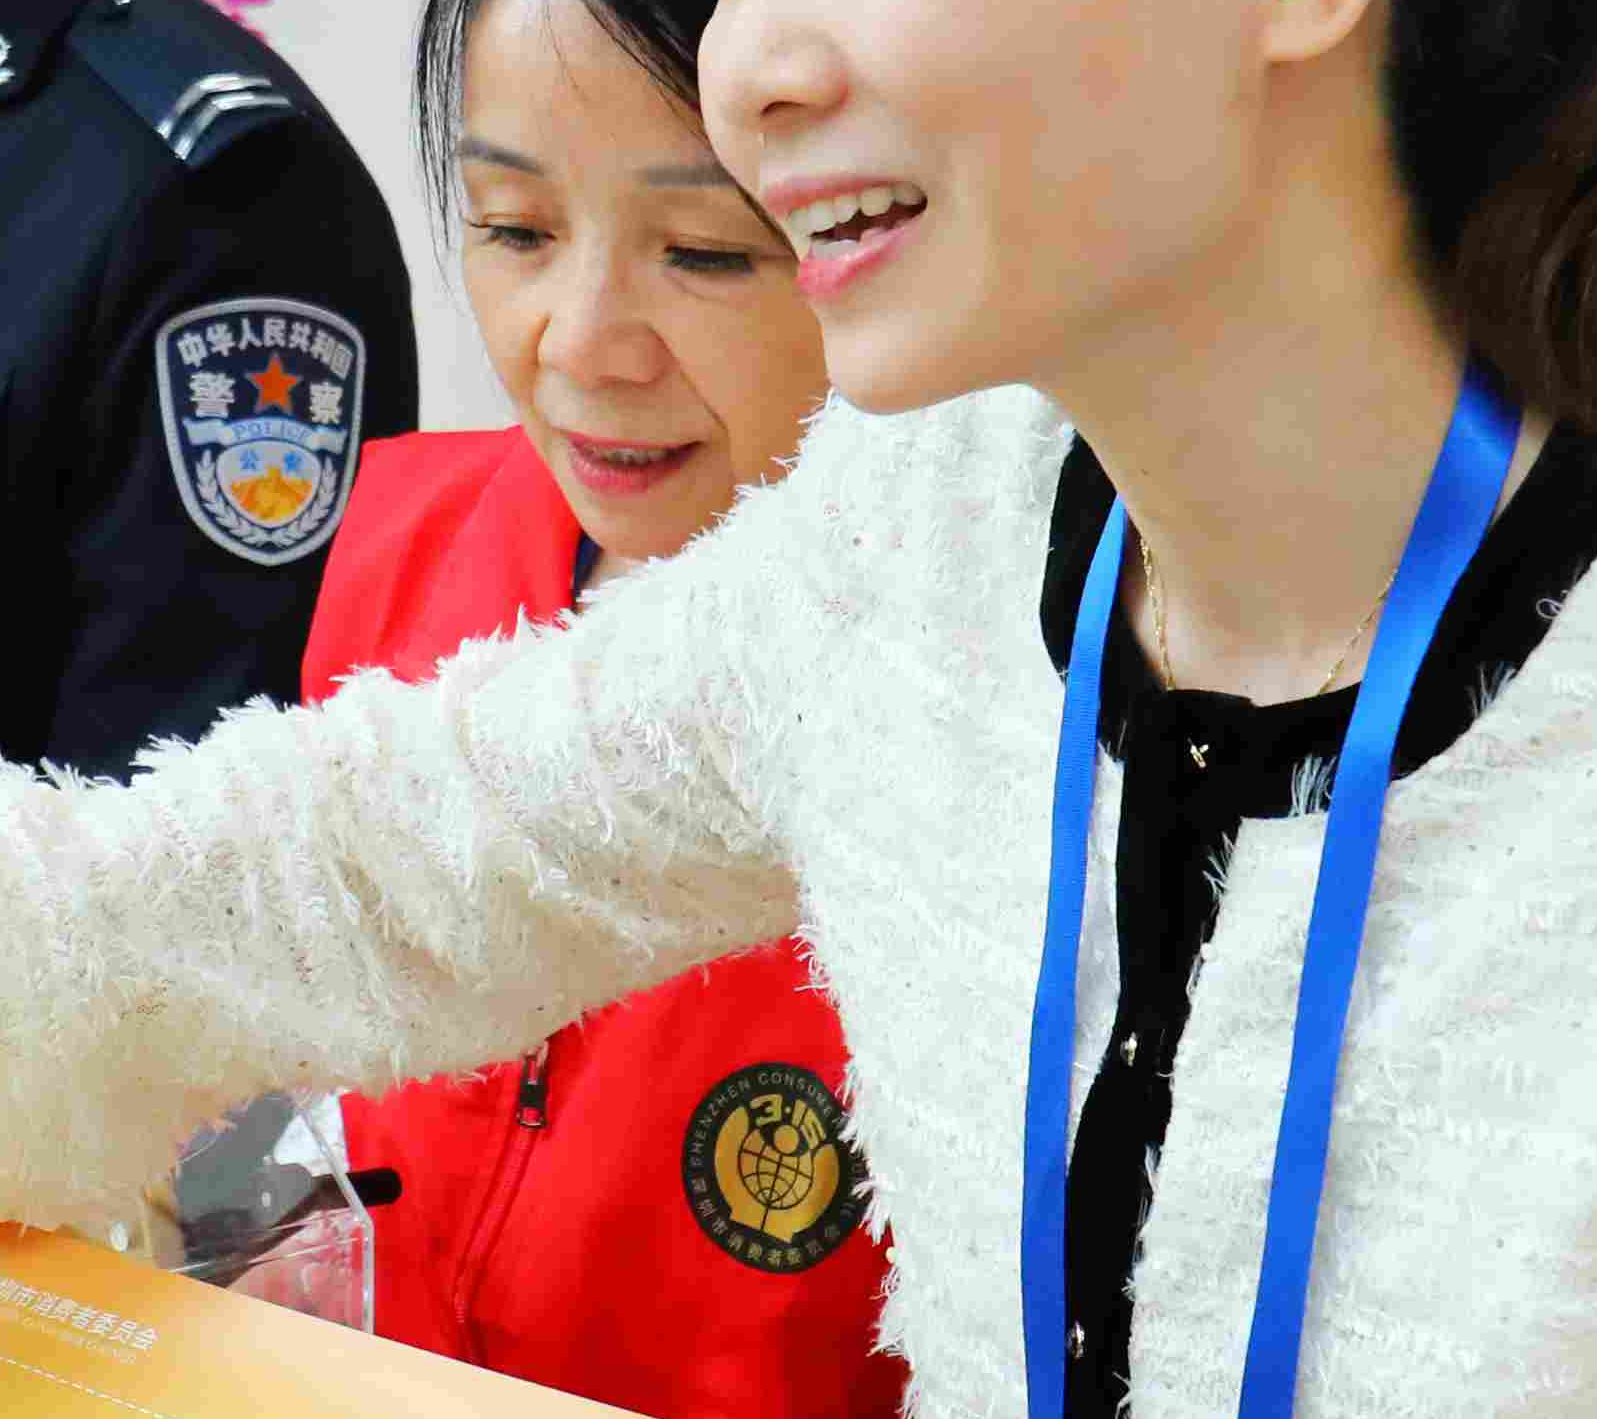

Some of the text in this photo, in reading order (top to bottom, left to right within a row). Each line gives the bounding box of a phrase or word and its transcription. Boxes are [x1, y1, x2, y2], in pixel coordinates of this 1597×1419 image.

[176, 317, 354, 380] 中华人民共和国
